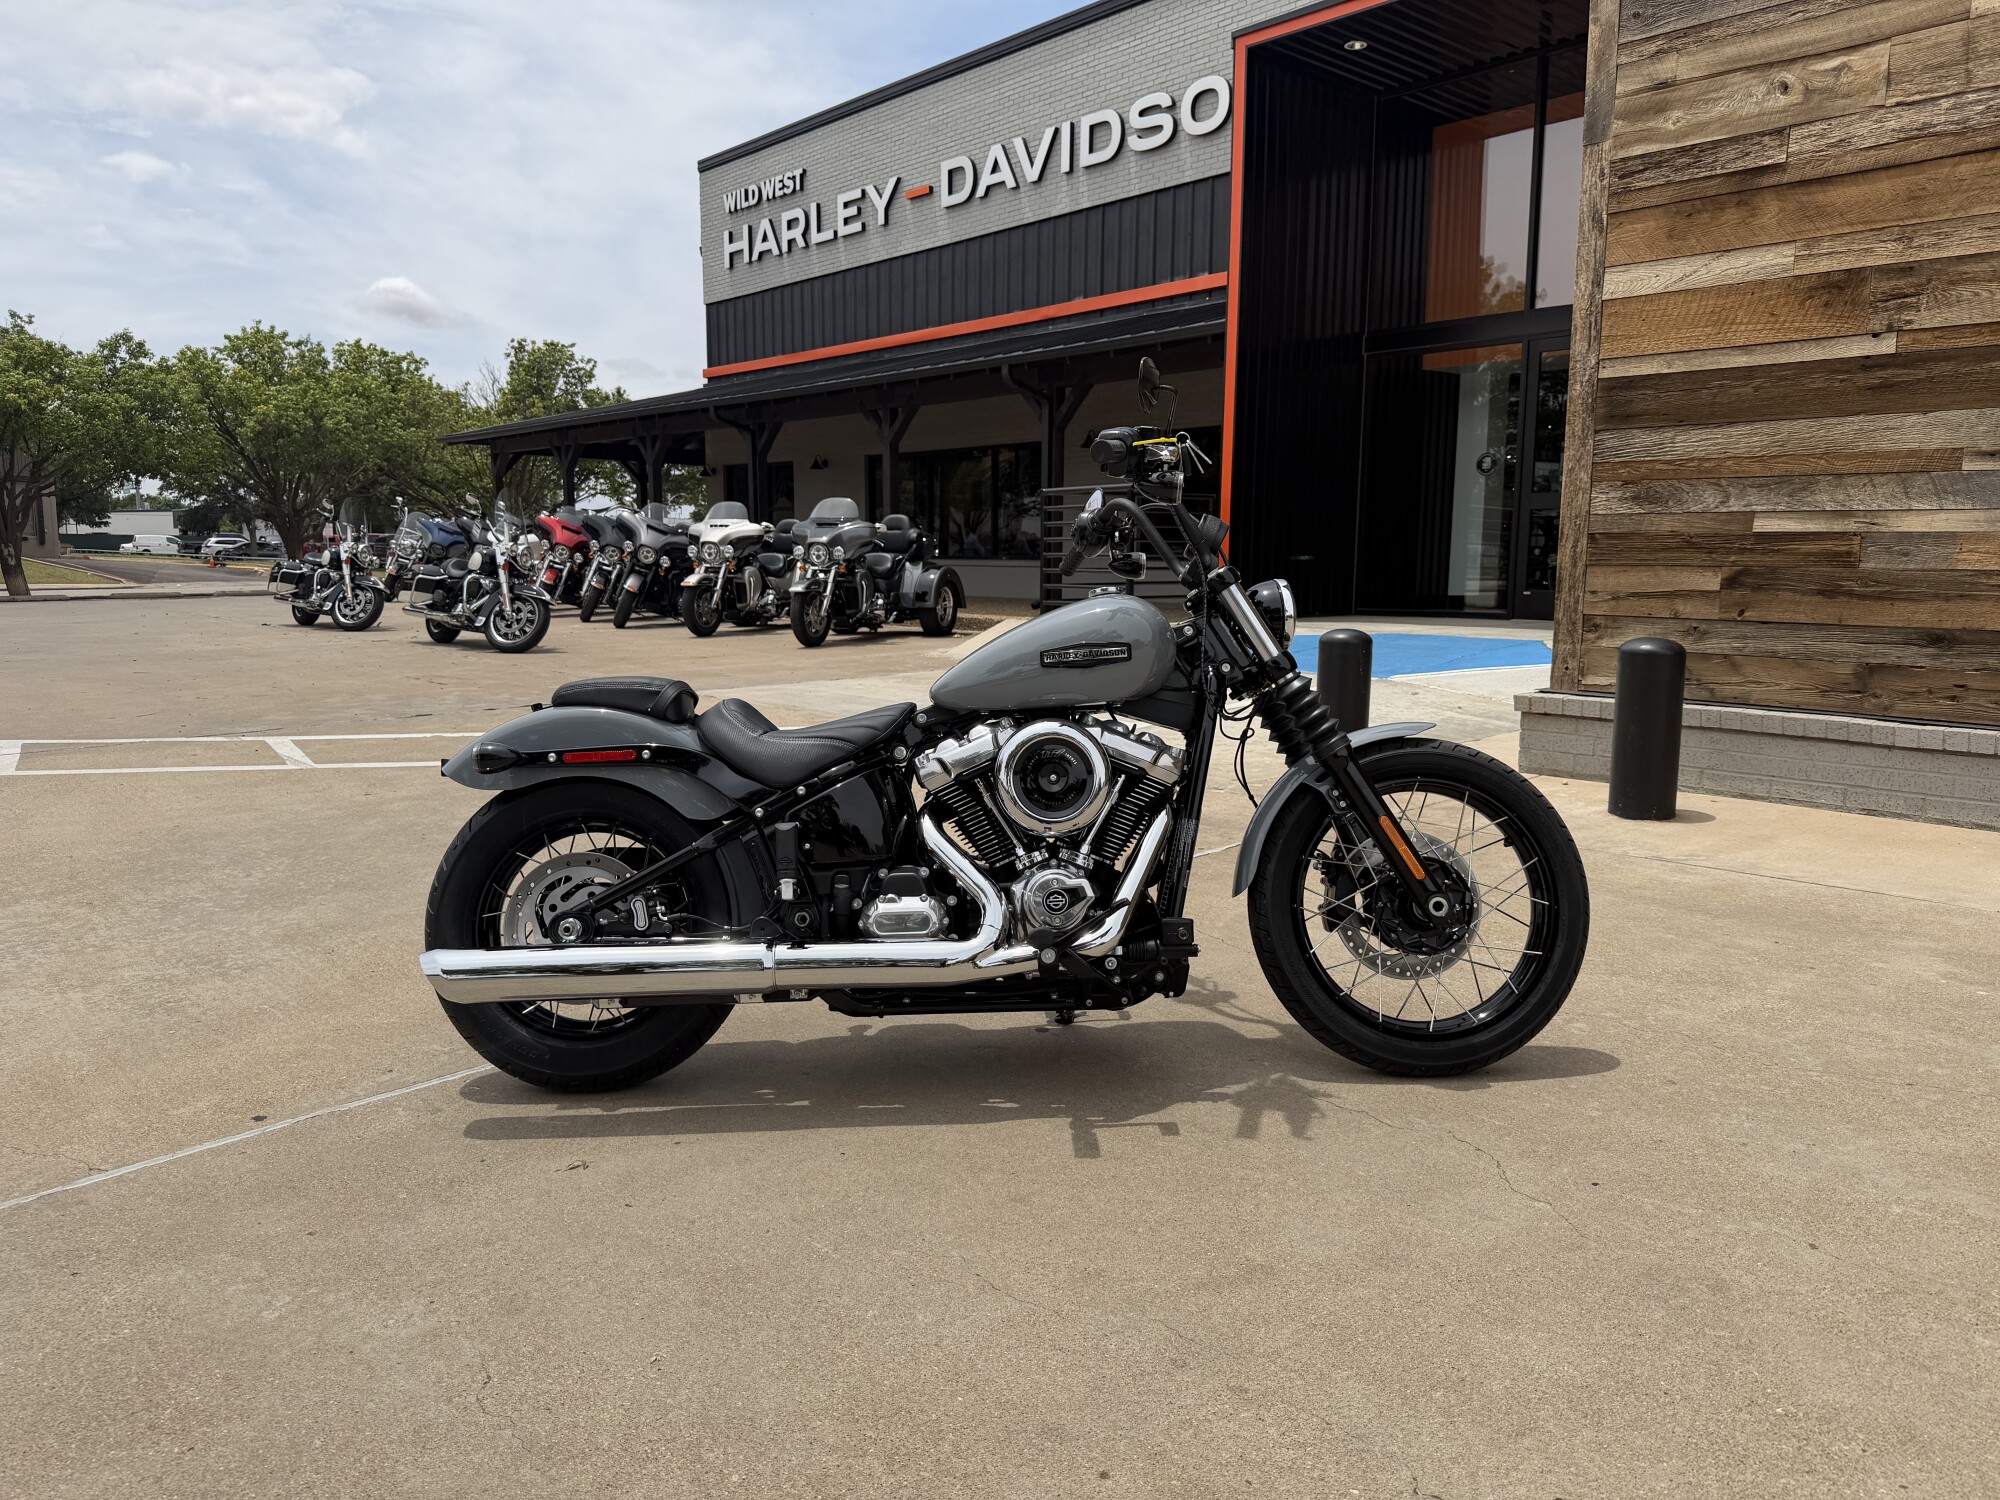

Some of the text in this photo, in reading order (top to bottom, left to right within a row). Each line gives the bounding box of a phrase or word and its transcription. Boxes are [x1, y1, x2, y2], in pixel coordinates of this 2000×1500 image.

[723, 168, 804, 214] WILD WEST
[1045, 647, 1127, 662] HARLEY-DAVIDSON
